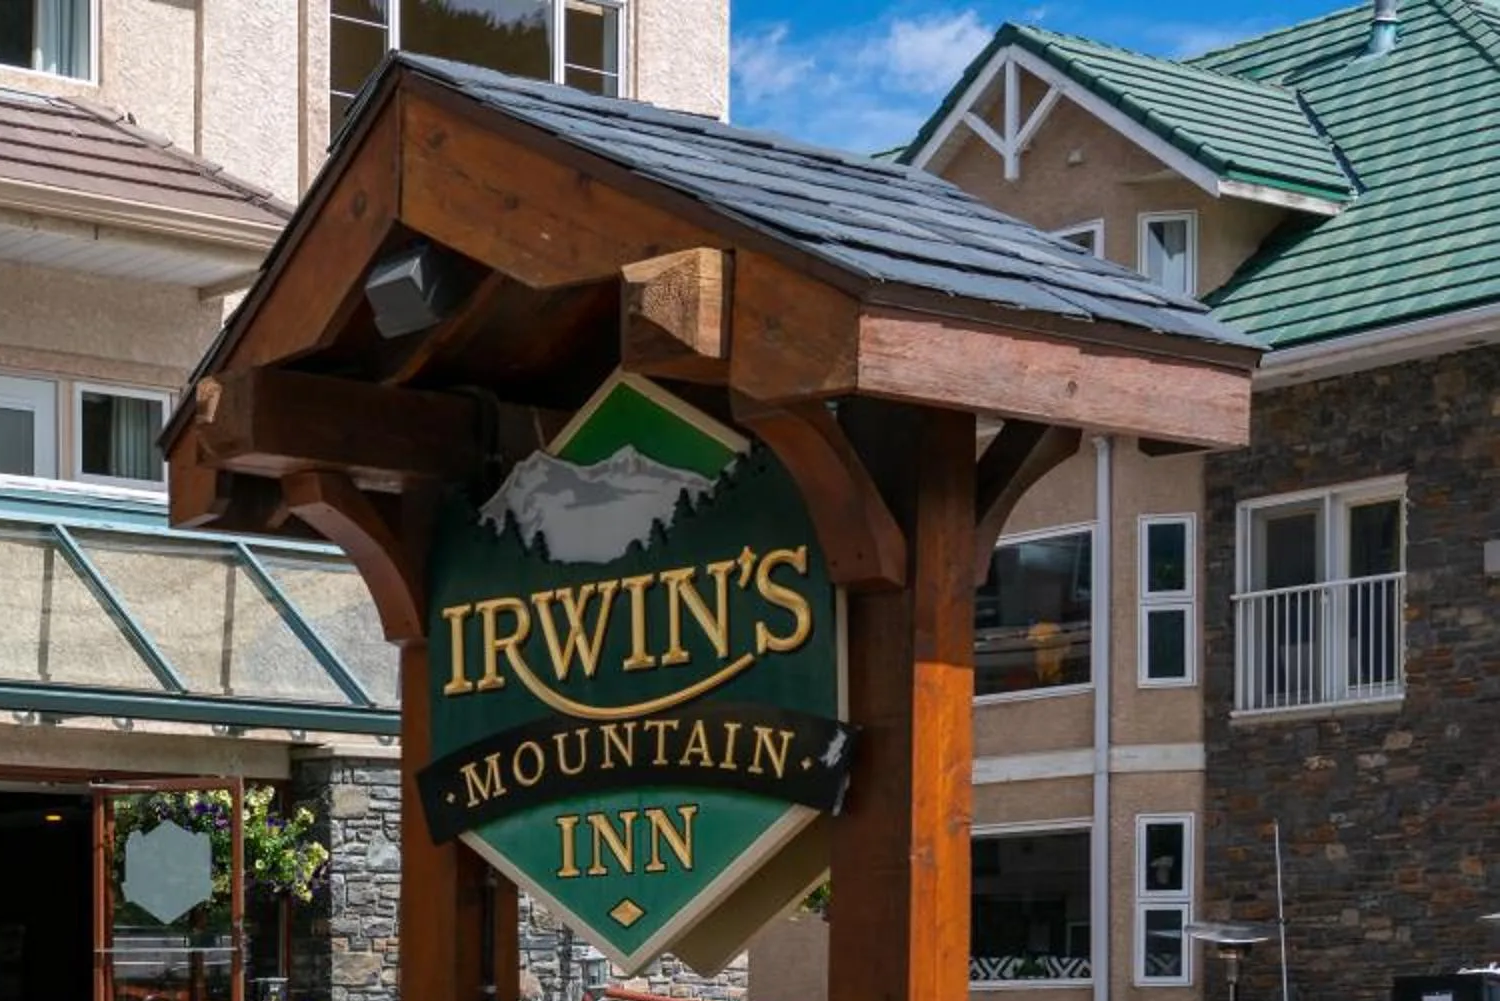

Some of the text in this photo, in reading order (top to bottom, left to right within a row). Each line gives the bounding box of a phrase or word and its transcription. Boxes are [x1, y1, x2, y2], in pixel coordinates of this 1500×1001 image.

[442, 546, 812, 718] IRWIN'S
[461, 721, 795, 807] MOUNTAIN
[556, 806, 697, 878] INN
